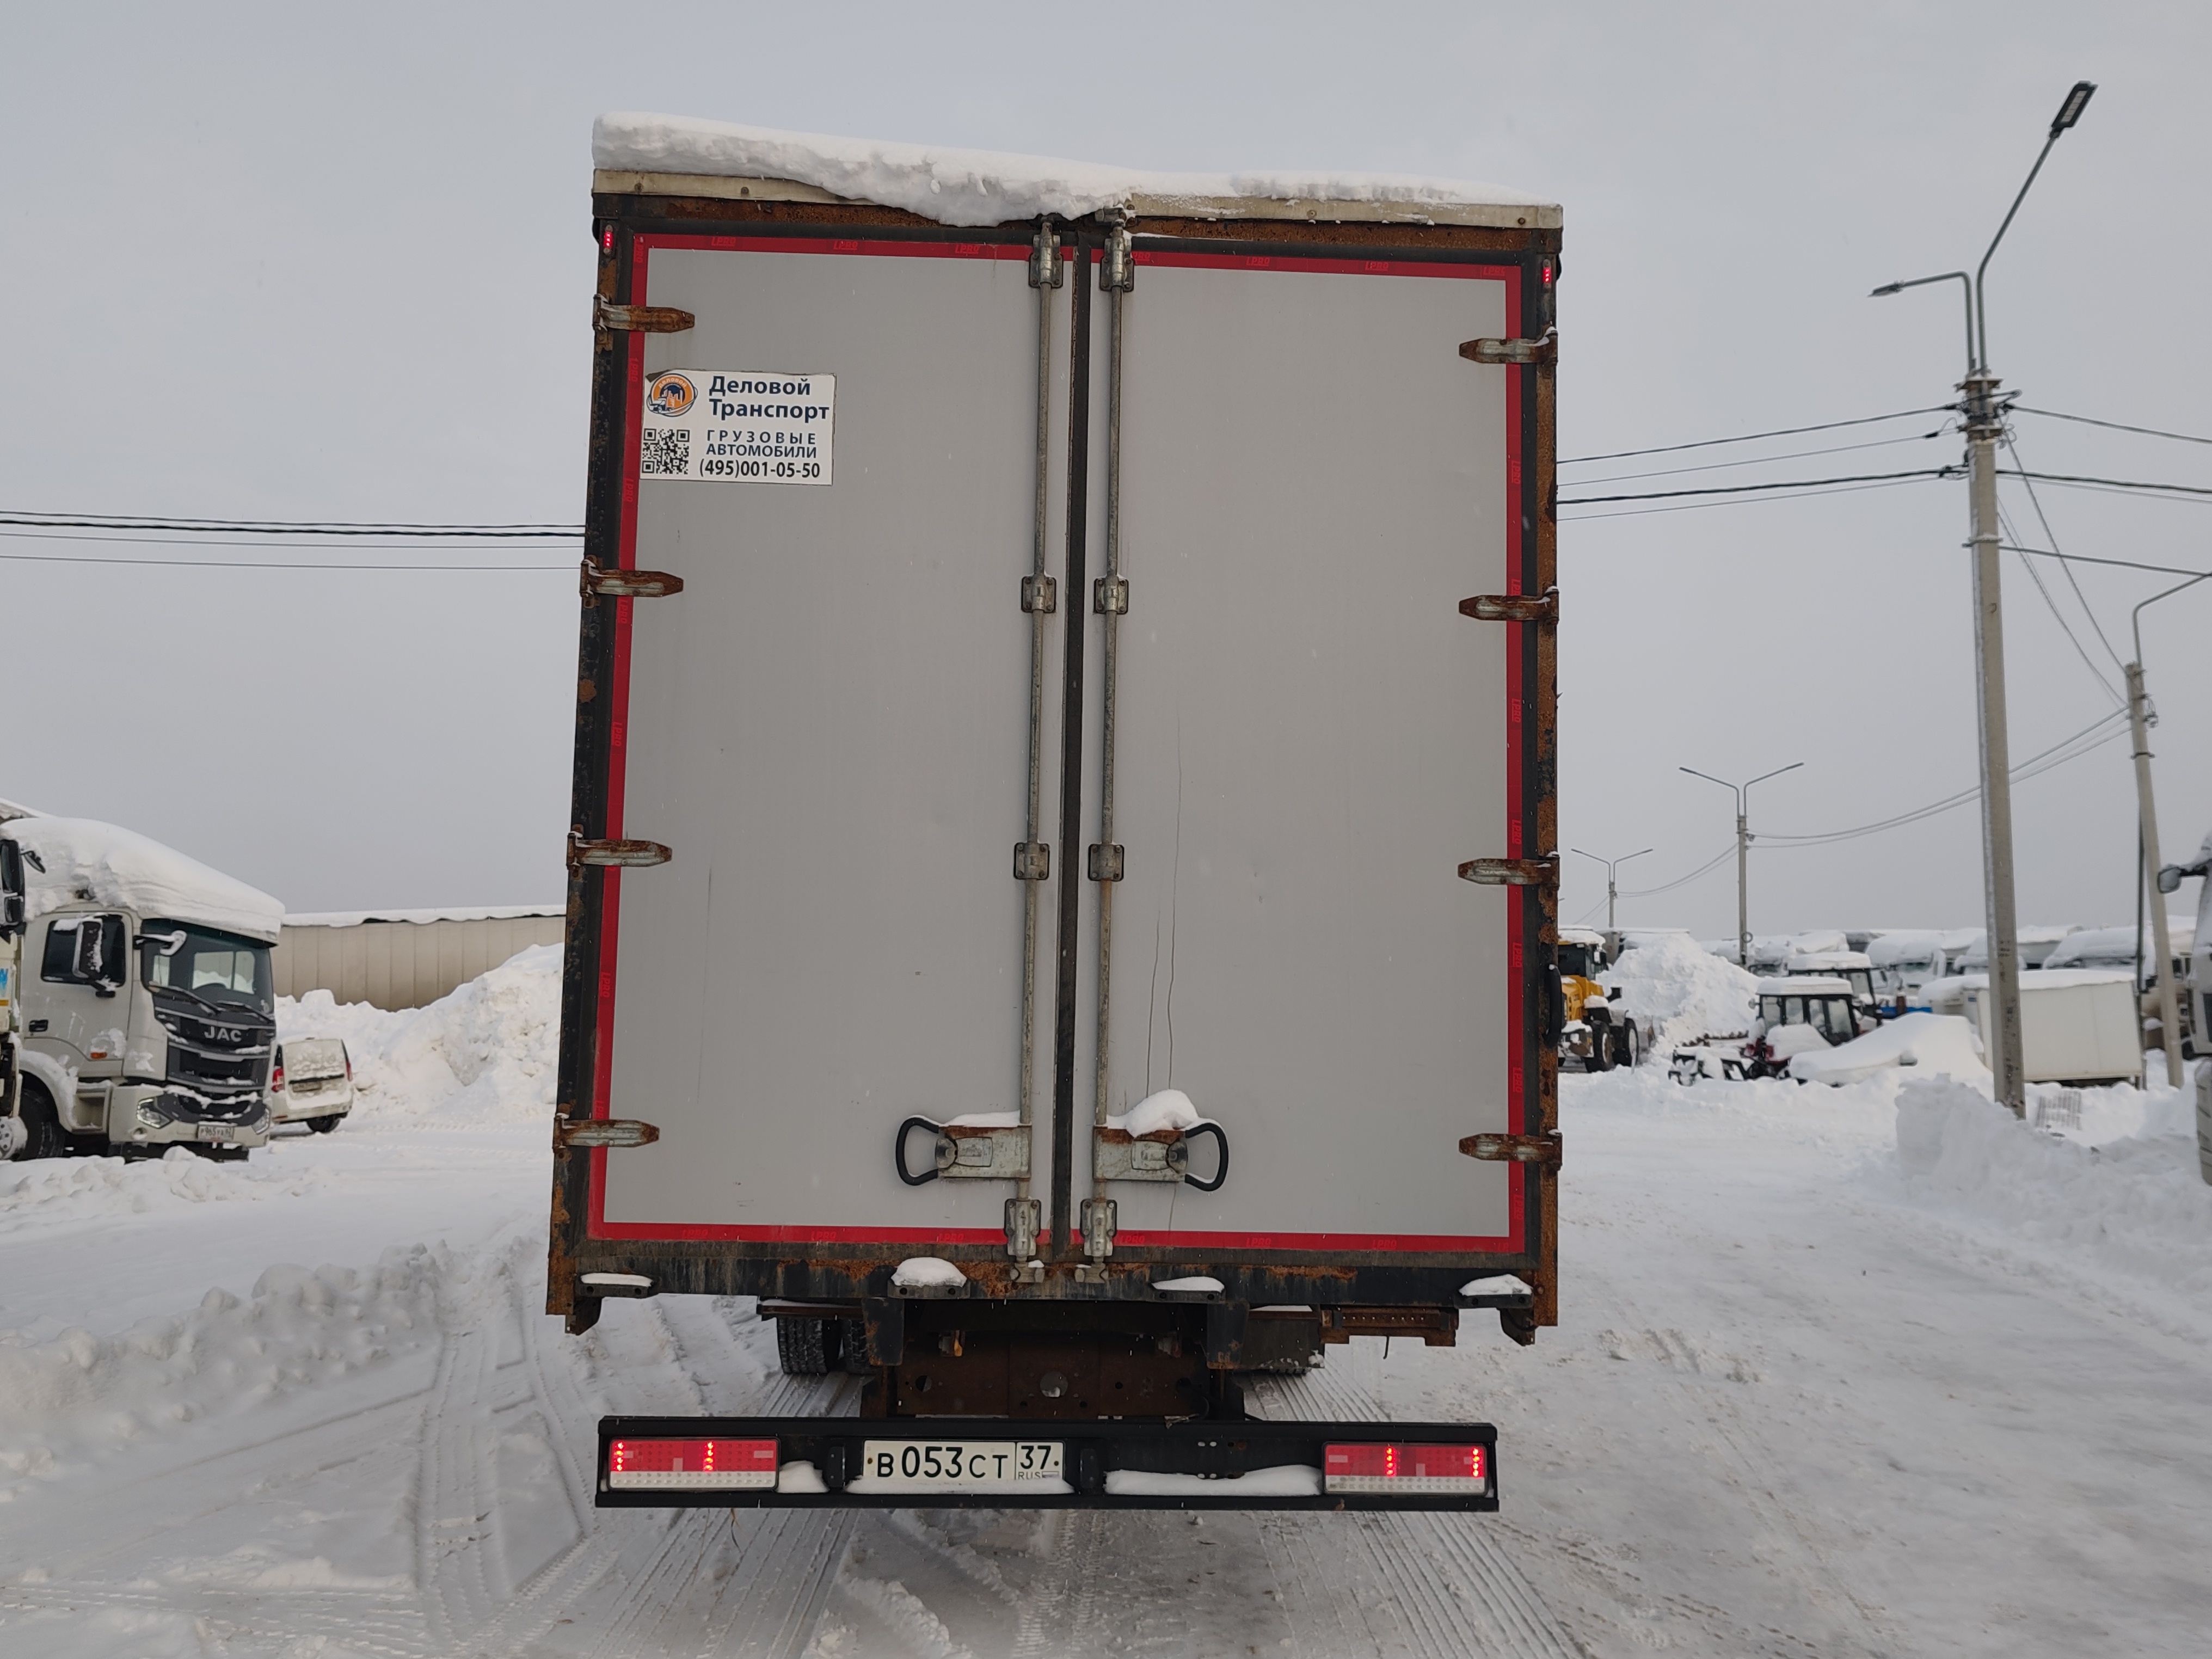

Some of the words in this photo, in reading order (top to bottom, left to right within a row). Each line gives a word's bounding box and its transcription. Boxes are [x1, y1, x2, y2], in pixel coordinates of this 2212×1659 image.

[709, 376, 810, 397] Деловой
[709, 398, 830, 423] Транспорт
[708, 429, 816, 445] ГРУЗОВЫЕ
[706, 444, 816, 458] АВТОМОБИЛИ
[699, 458, 820, 478] (495)001-05-50
[204, 1026, 242, 1042] JAC
[1020, 1446, 1051, 1470] 37
